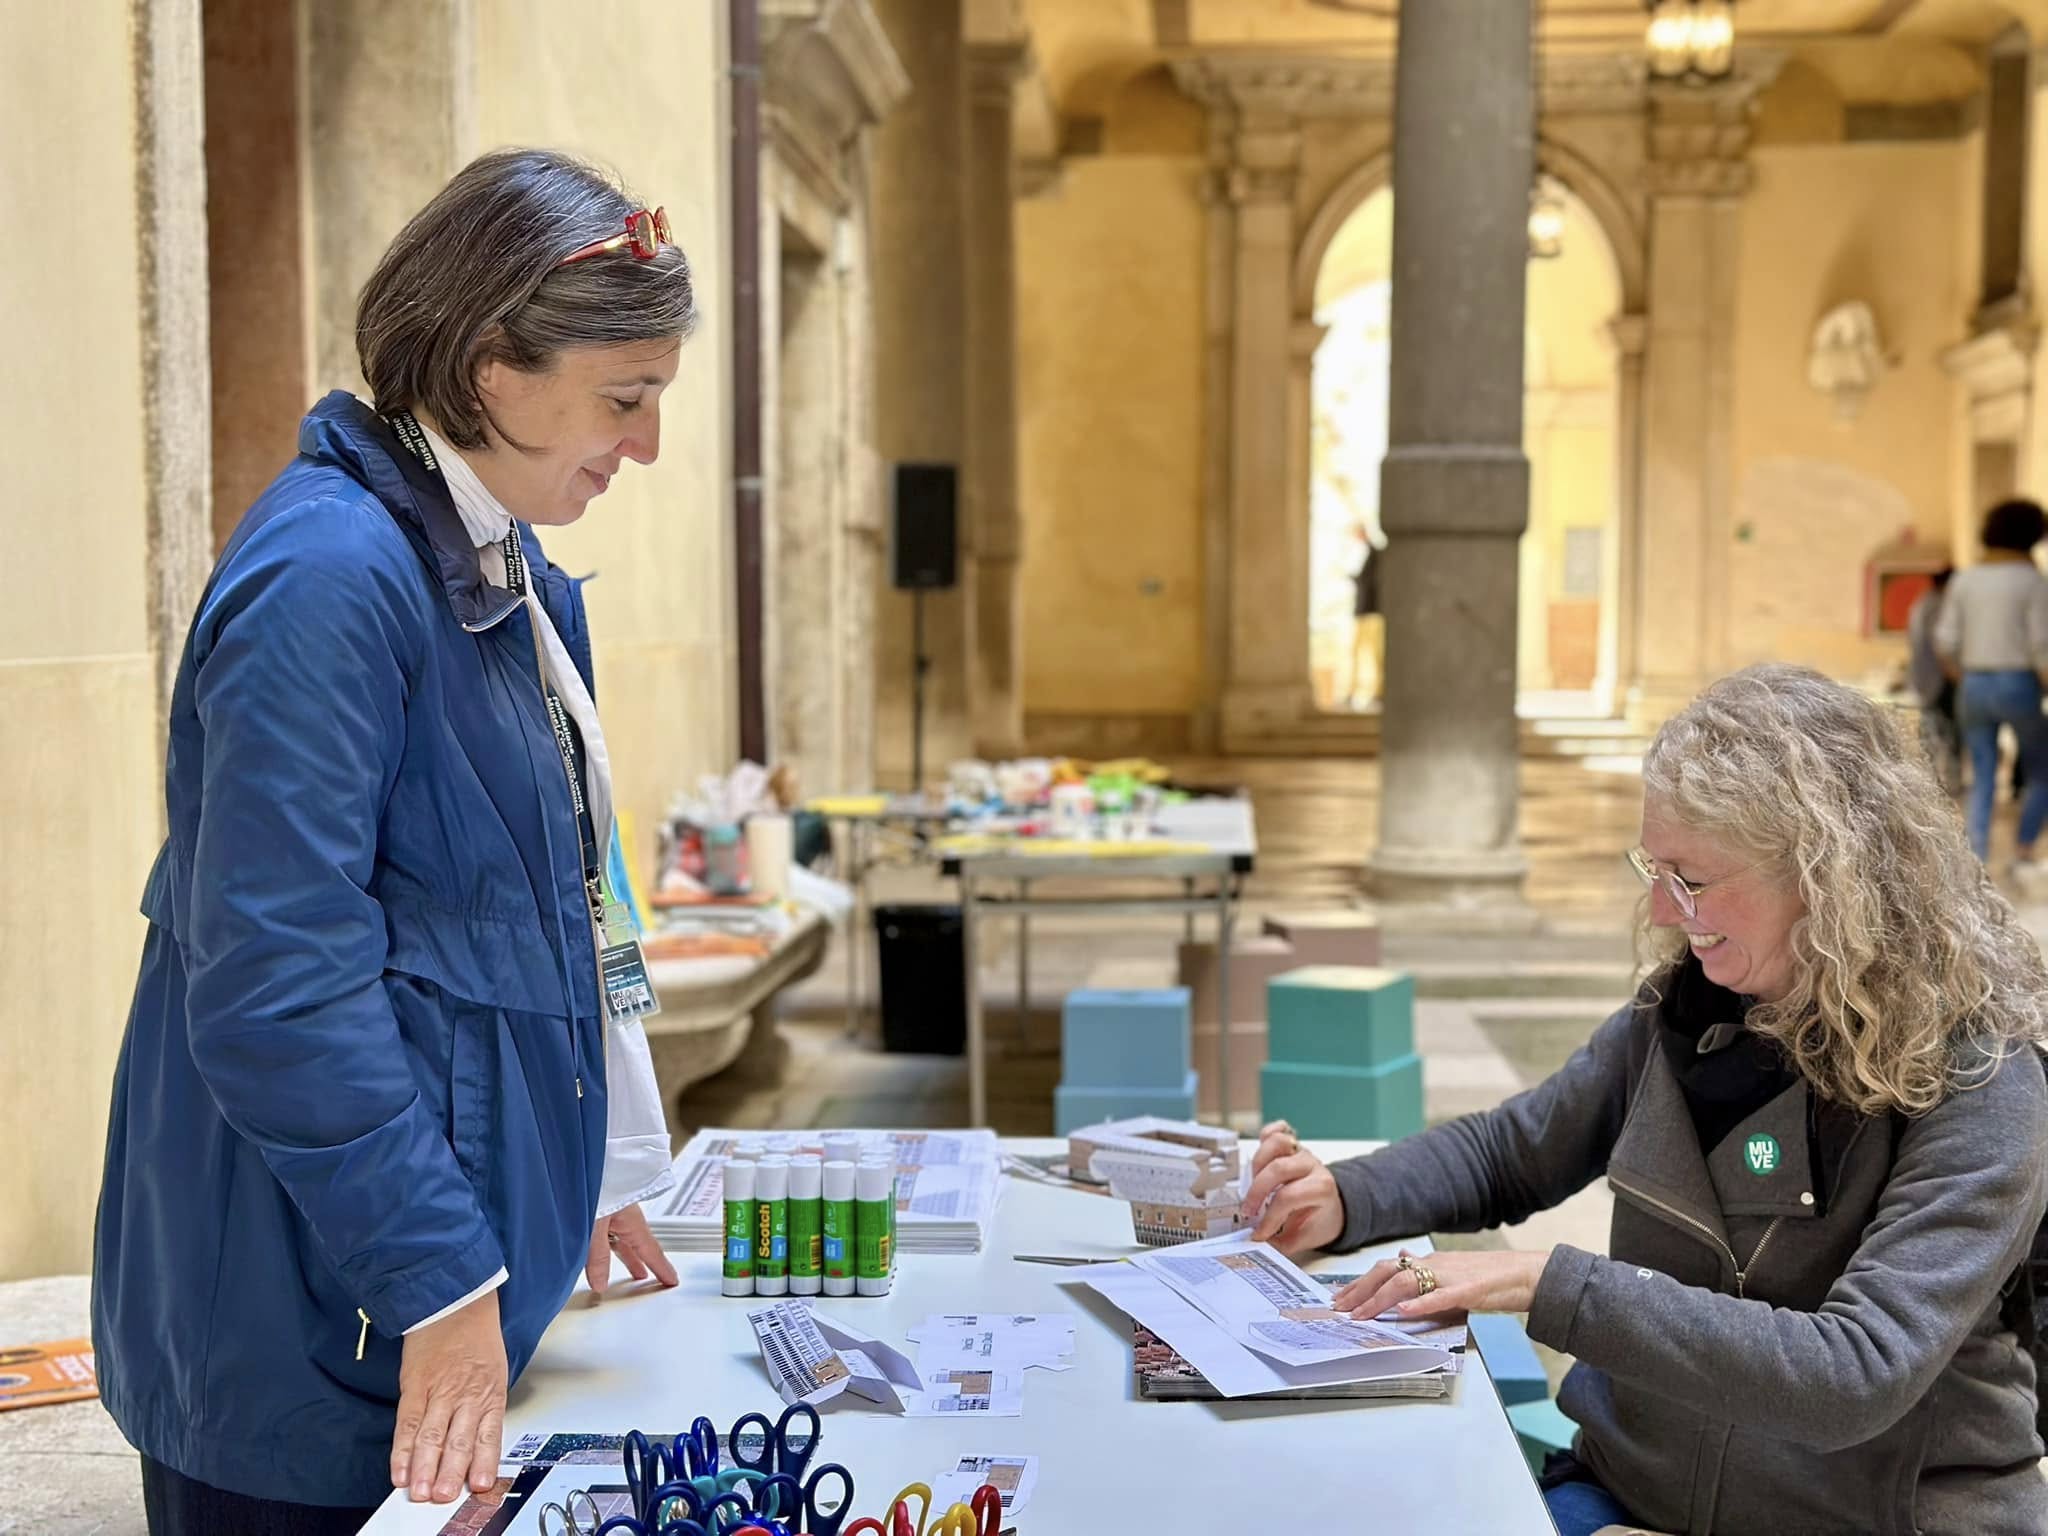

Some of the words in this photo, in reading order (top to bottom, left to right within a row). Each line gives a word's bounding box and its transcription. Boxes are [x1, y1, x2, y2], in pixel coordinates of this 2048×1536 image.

[393, 418, 416, 455] azione
[413, 438, 437, 471] Musei
[507, 558, 517, 587] Civici
[614, 999, 626, 1009] VE
[1748, 1141, 1773, 1155] MU
[1751, 1154, 1774, 1168] VE
[759, 1204, 770, 1257] Scotch
